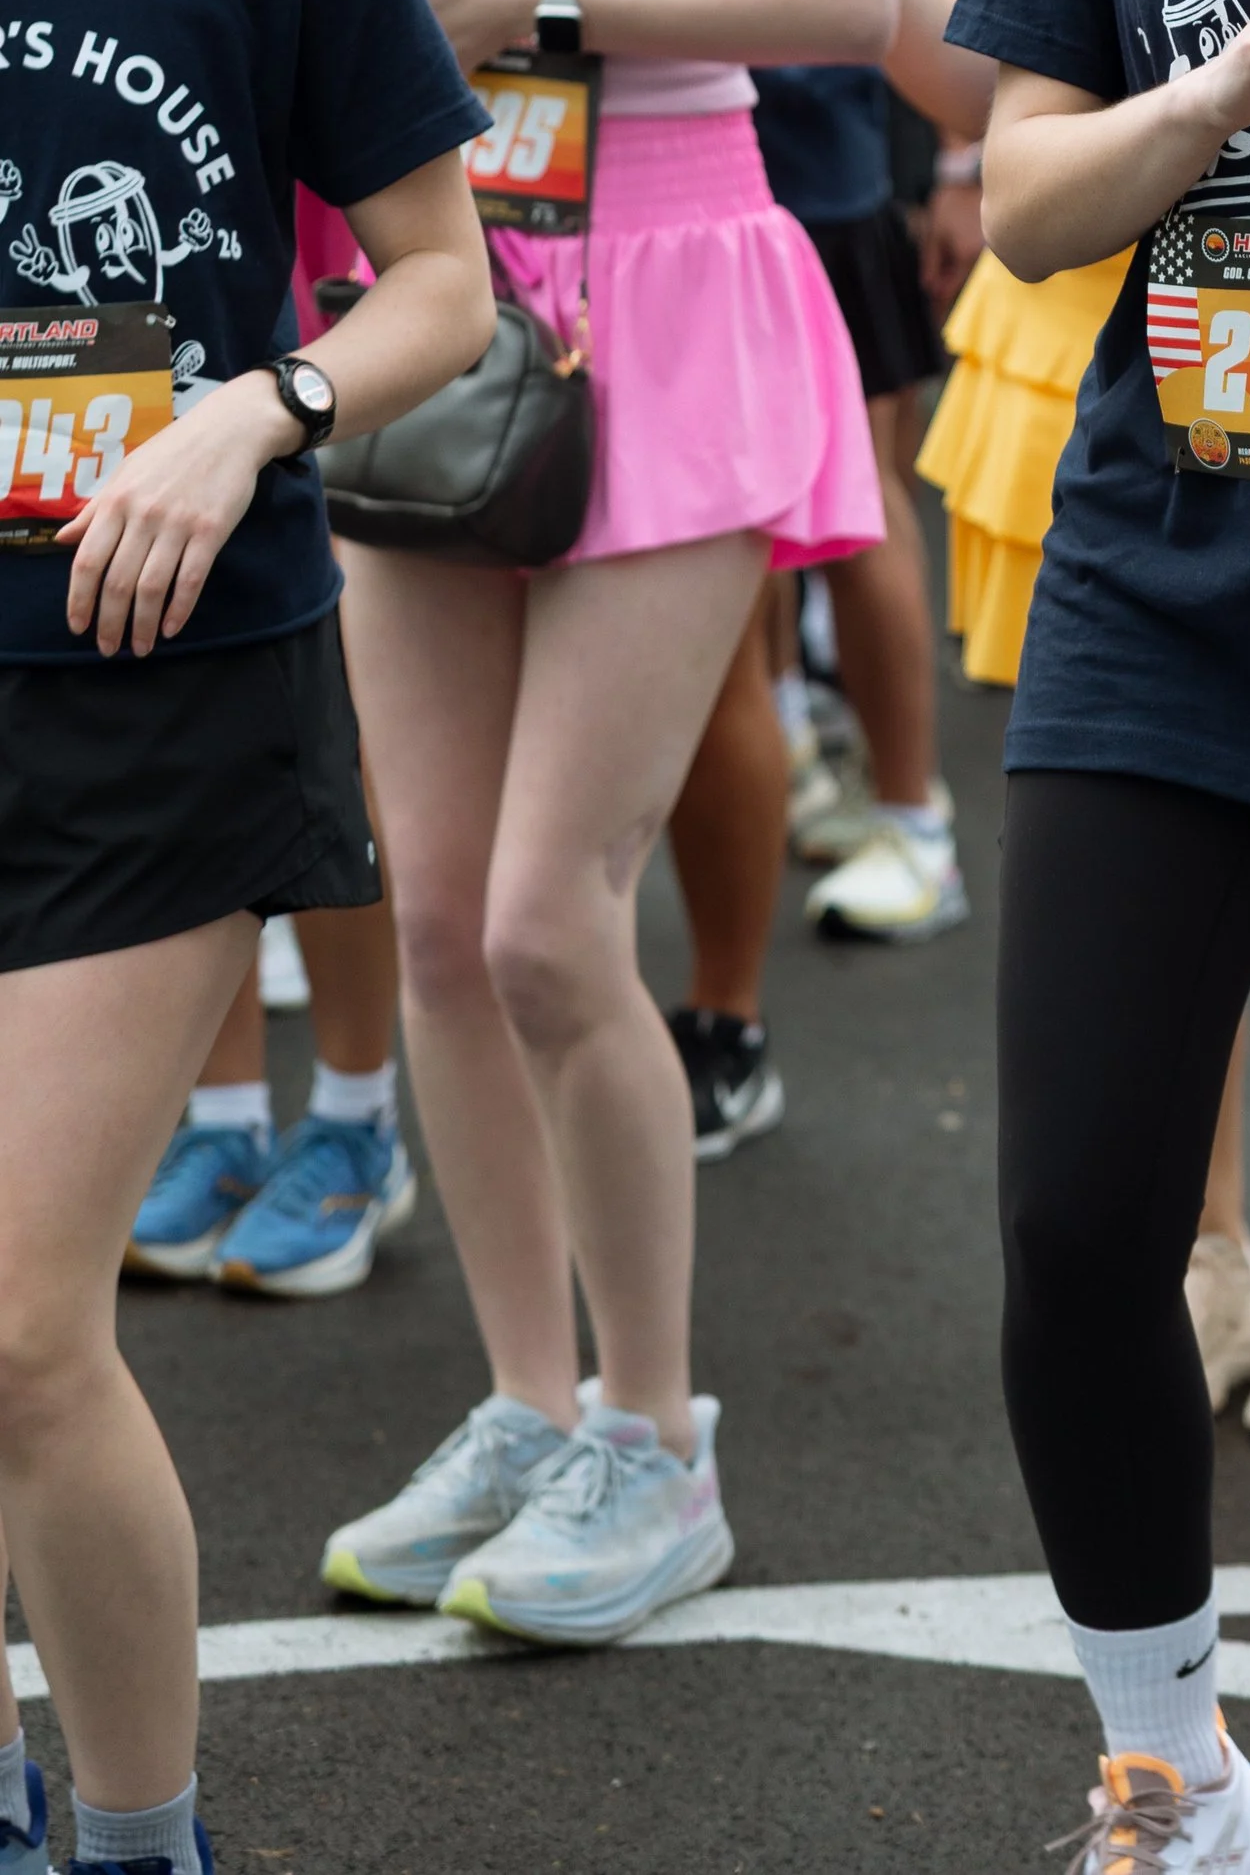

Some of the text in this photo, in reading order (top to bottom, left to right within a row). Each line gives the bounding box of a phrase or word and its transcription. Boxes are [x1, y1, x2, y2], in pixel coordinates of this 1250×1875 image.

[71, 30, 236, 195] HOUSE
[217, 228, 243, 261] 26
[1223, 267, 1244, 280] GOD.
